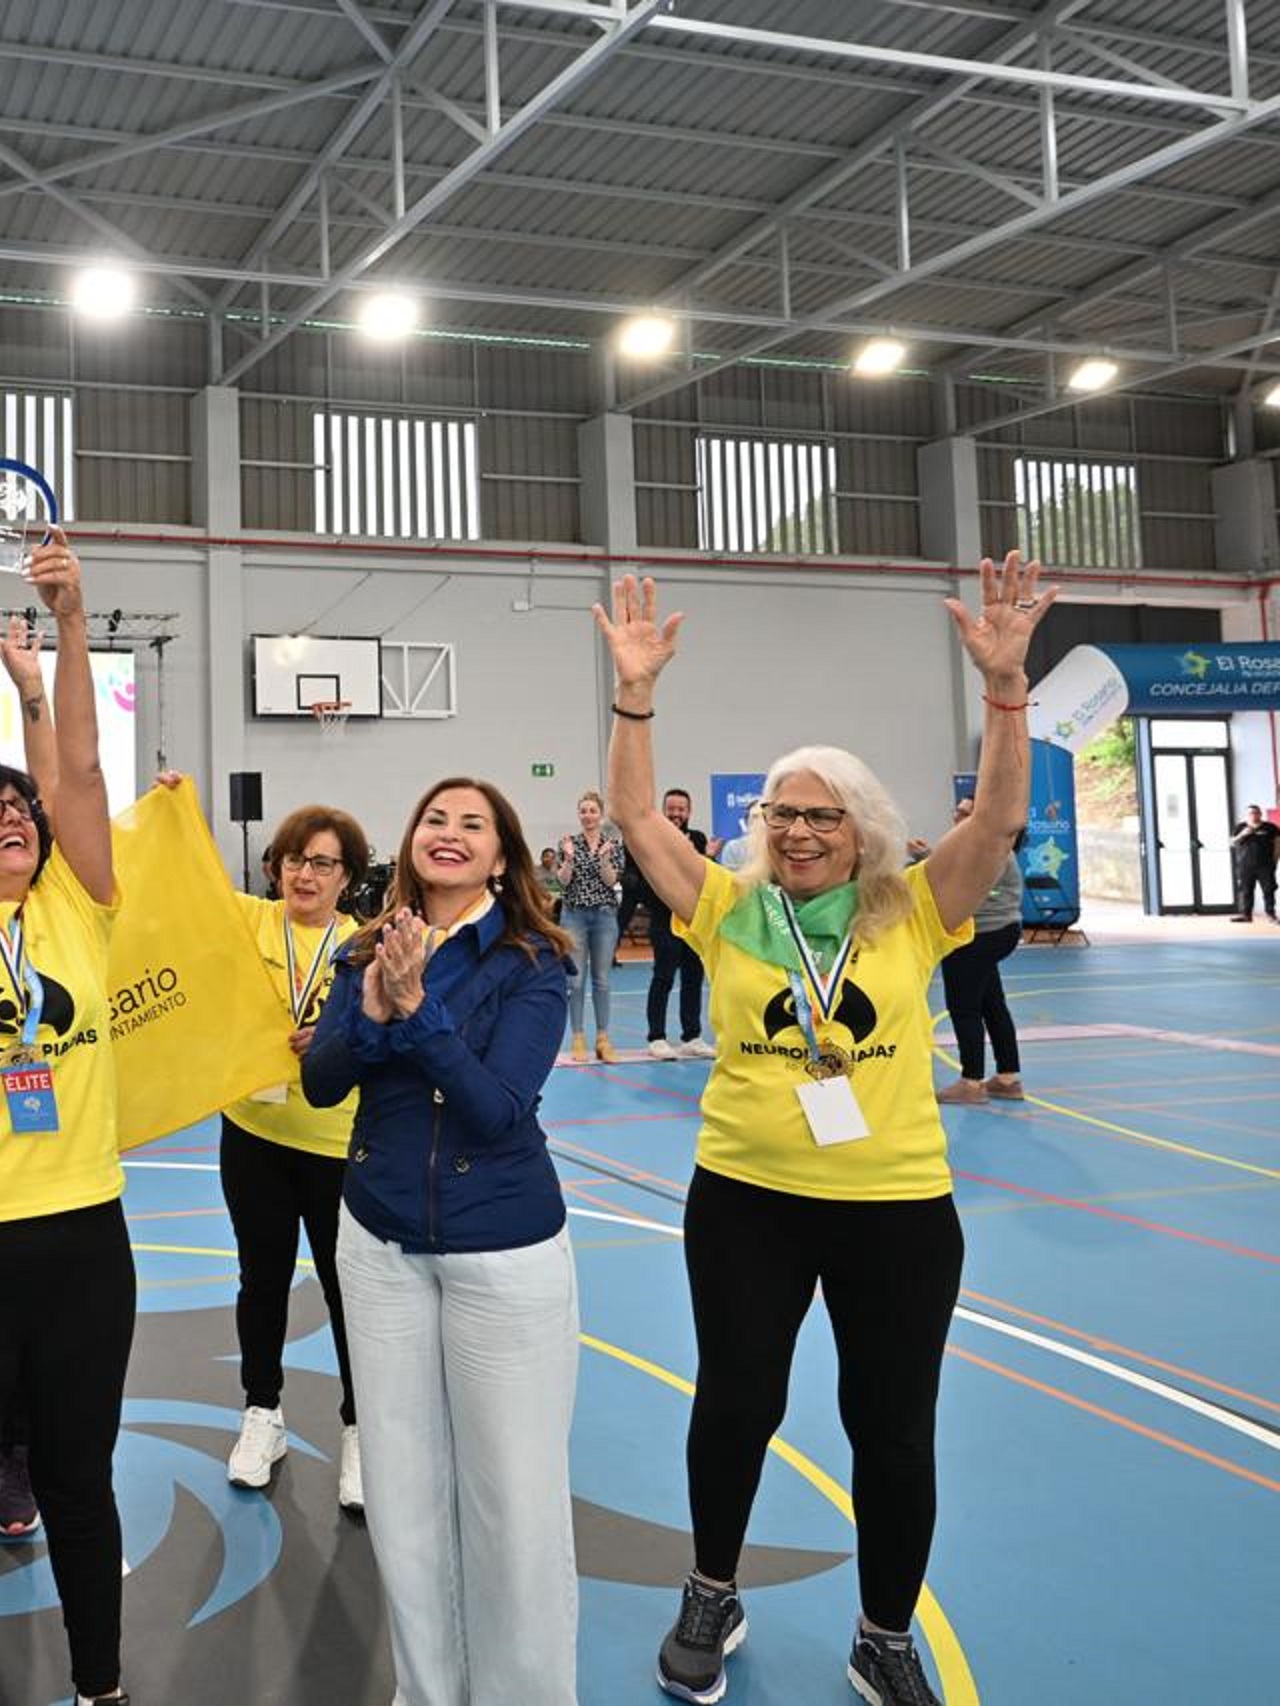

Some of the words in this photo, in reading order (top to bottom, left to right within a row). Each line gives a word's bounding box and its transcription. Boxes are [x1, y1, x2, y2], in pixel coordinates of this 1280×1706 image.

[1215, 655, 1235, 671] El
[1150, 682, 1249, 696] CONCEJALIA
[110, 991, 187, 1041] NTAMIENTO
